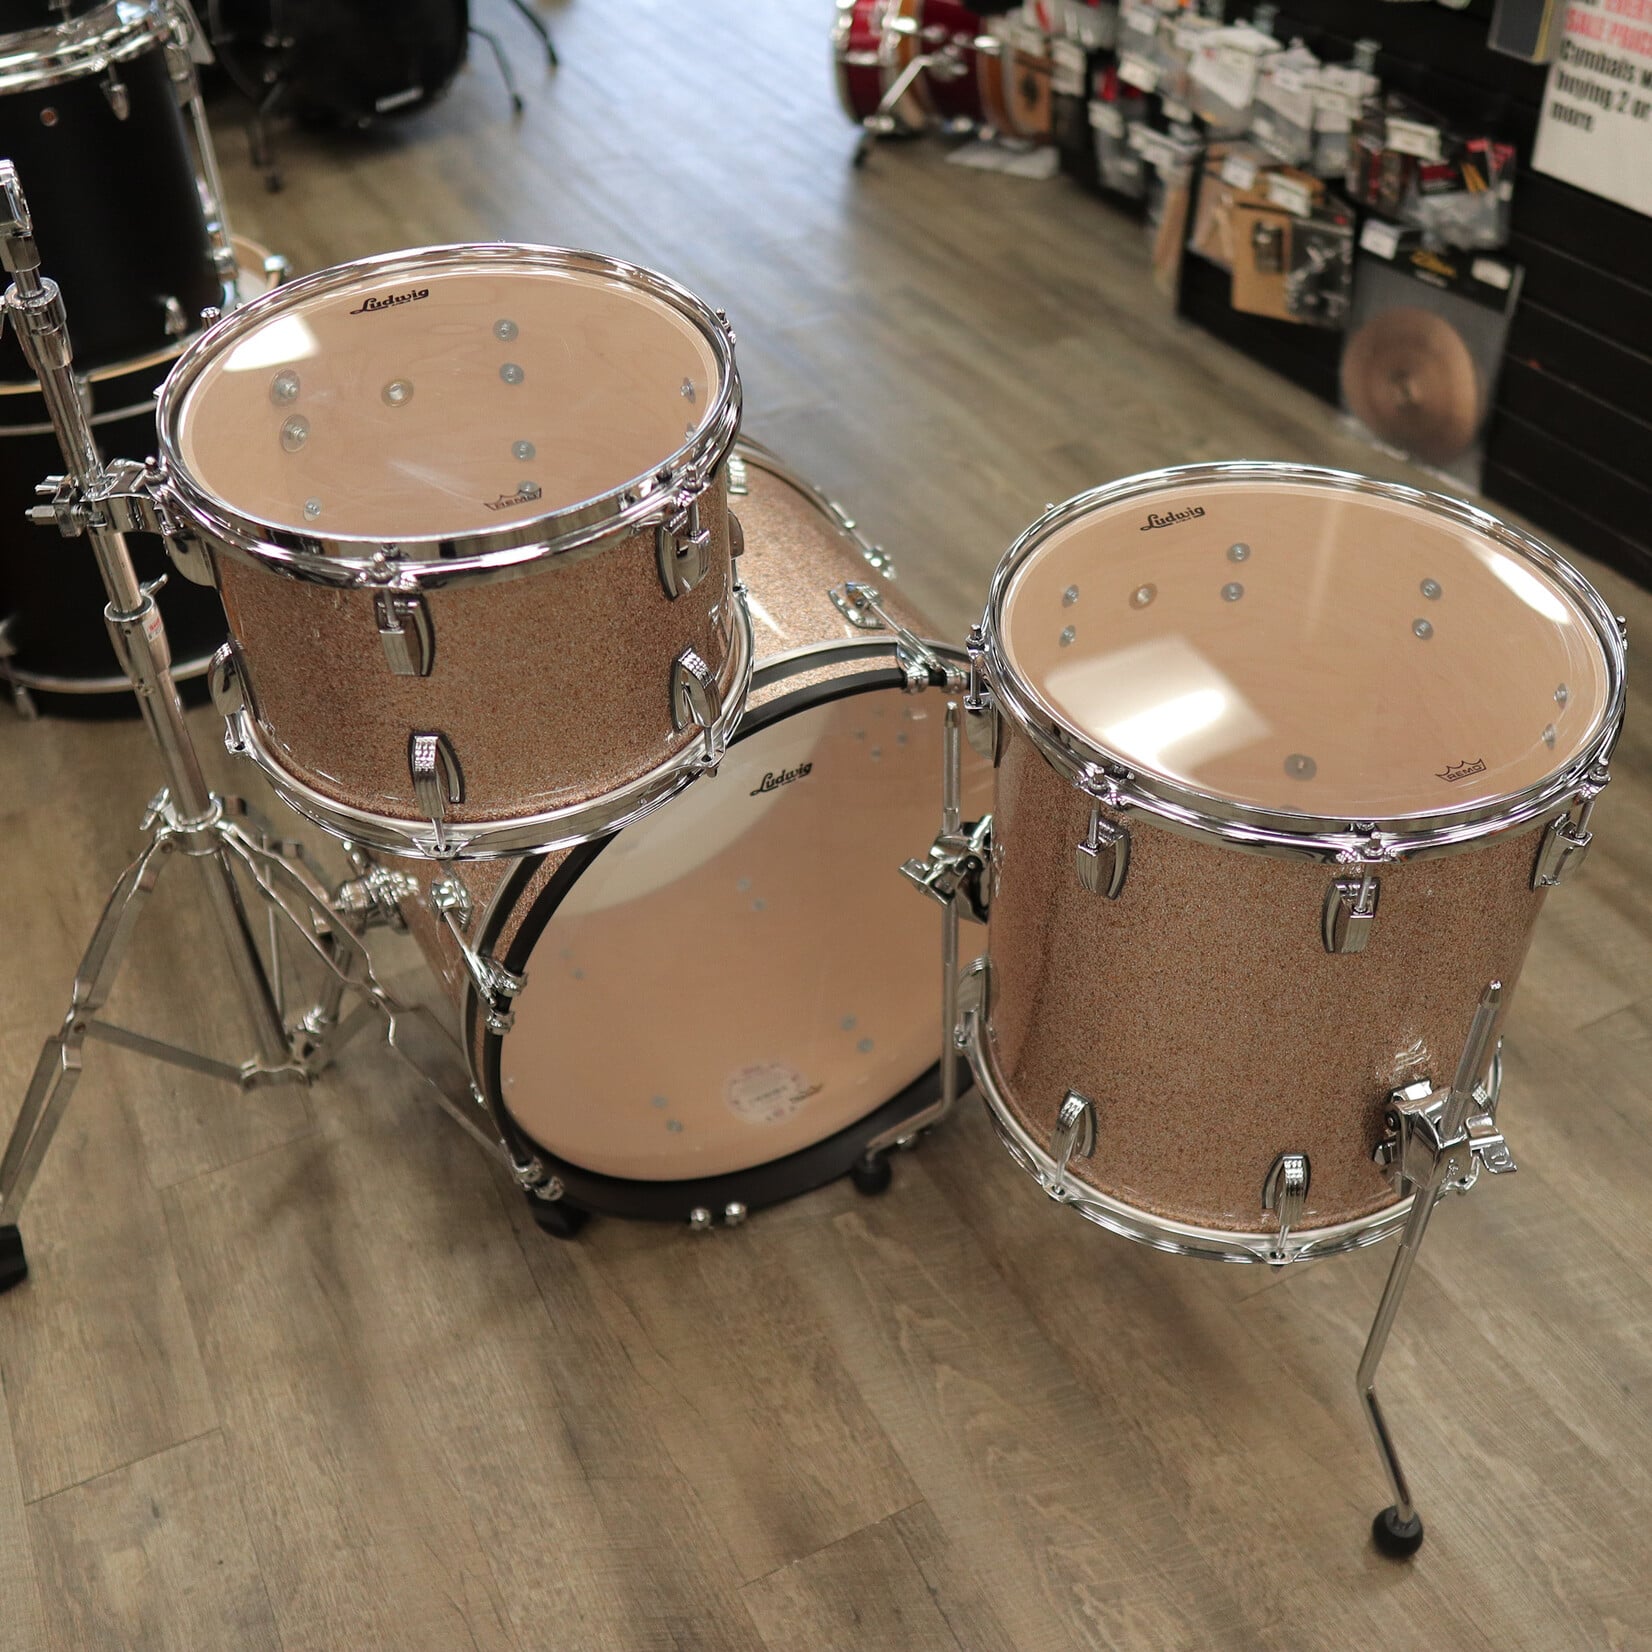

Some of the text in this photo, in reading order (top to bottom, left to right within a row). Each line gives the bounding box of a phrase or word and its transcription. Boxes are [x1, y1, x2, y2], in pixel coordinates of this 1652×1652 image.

[1560, 40, 1635, 82] Cymbals
[1557, 70, 1652, 122] buying 2 or
[1553, 102, 1593, 131] more
[349, 288, 430, 315] Ludwig
[1140, 506, 1206, 531] Ludwig
[749, 762, 813, 797] Ludwig
